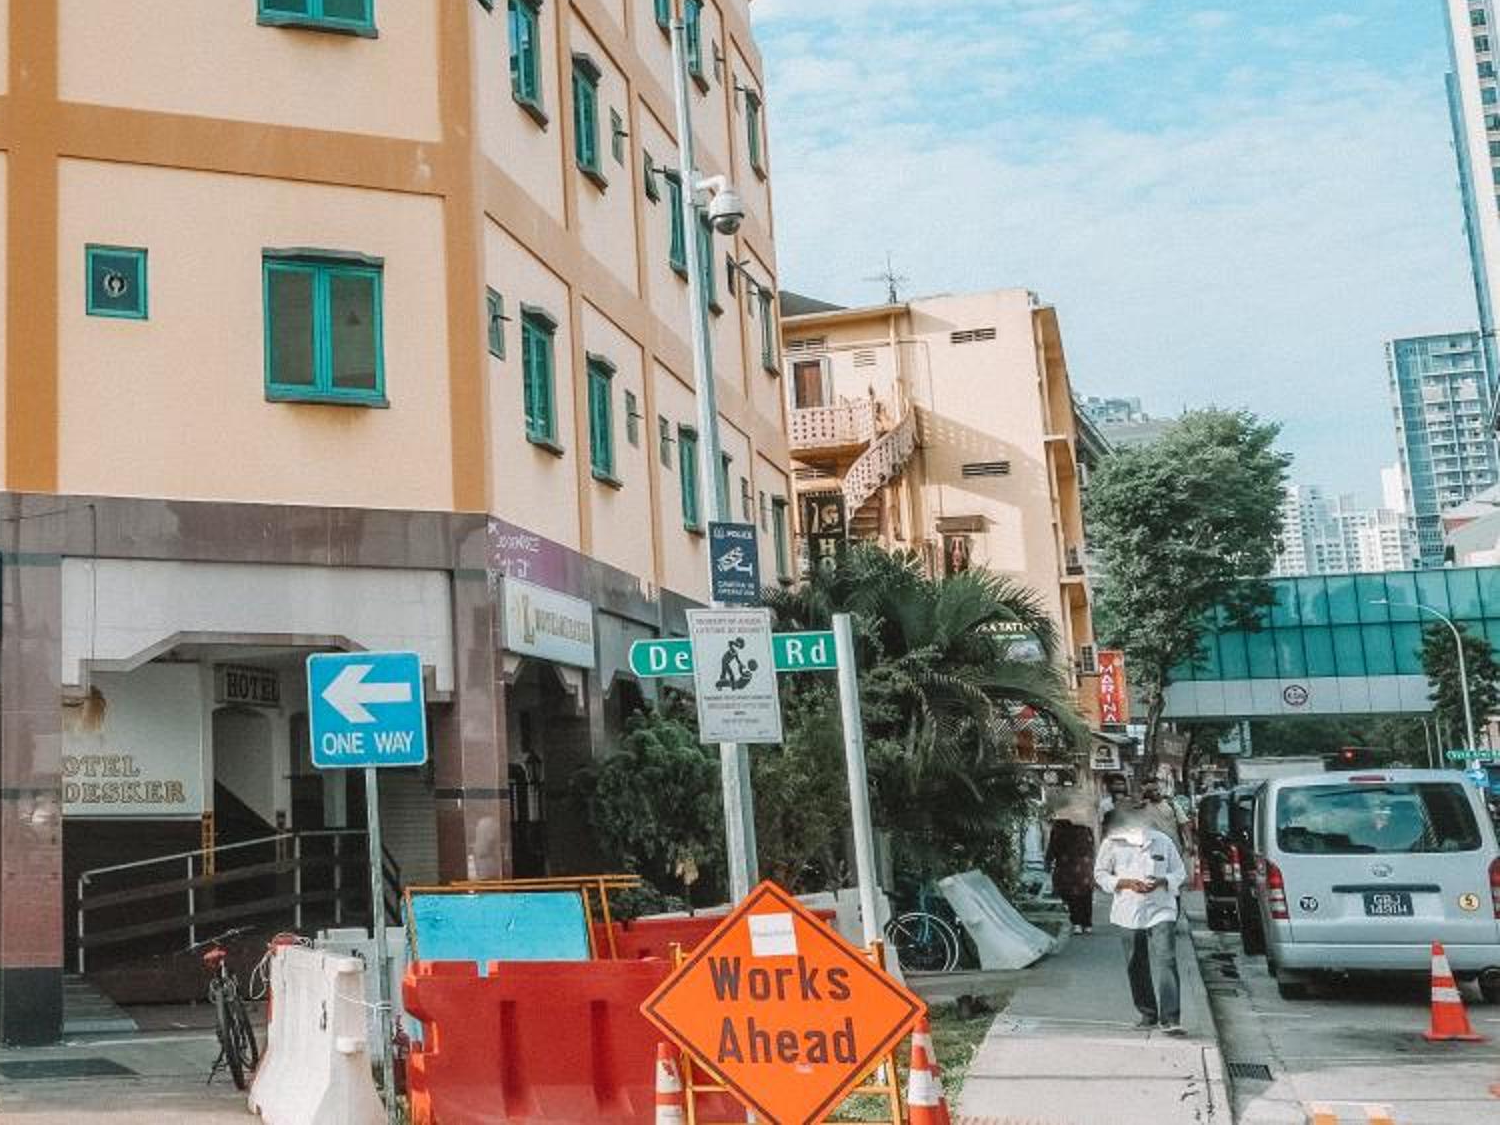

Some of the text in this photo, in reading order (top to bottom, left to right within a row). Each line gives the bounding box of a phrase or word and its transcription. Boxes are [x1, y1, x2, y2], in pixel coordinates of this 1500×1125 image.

[786, 638, 827, 665] Rd
[227, 672, 279, 701] HOTEL
[1100, 664, 1117, 722] MARINA
[322, 731, 415, 755] ONE WAY
[63, 779, 187, 804] DESKER
[708, 956, 851, 1002] Works
[717, 1017, 858, 1064] Ahead
